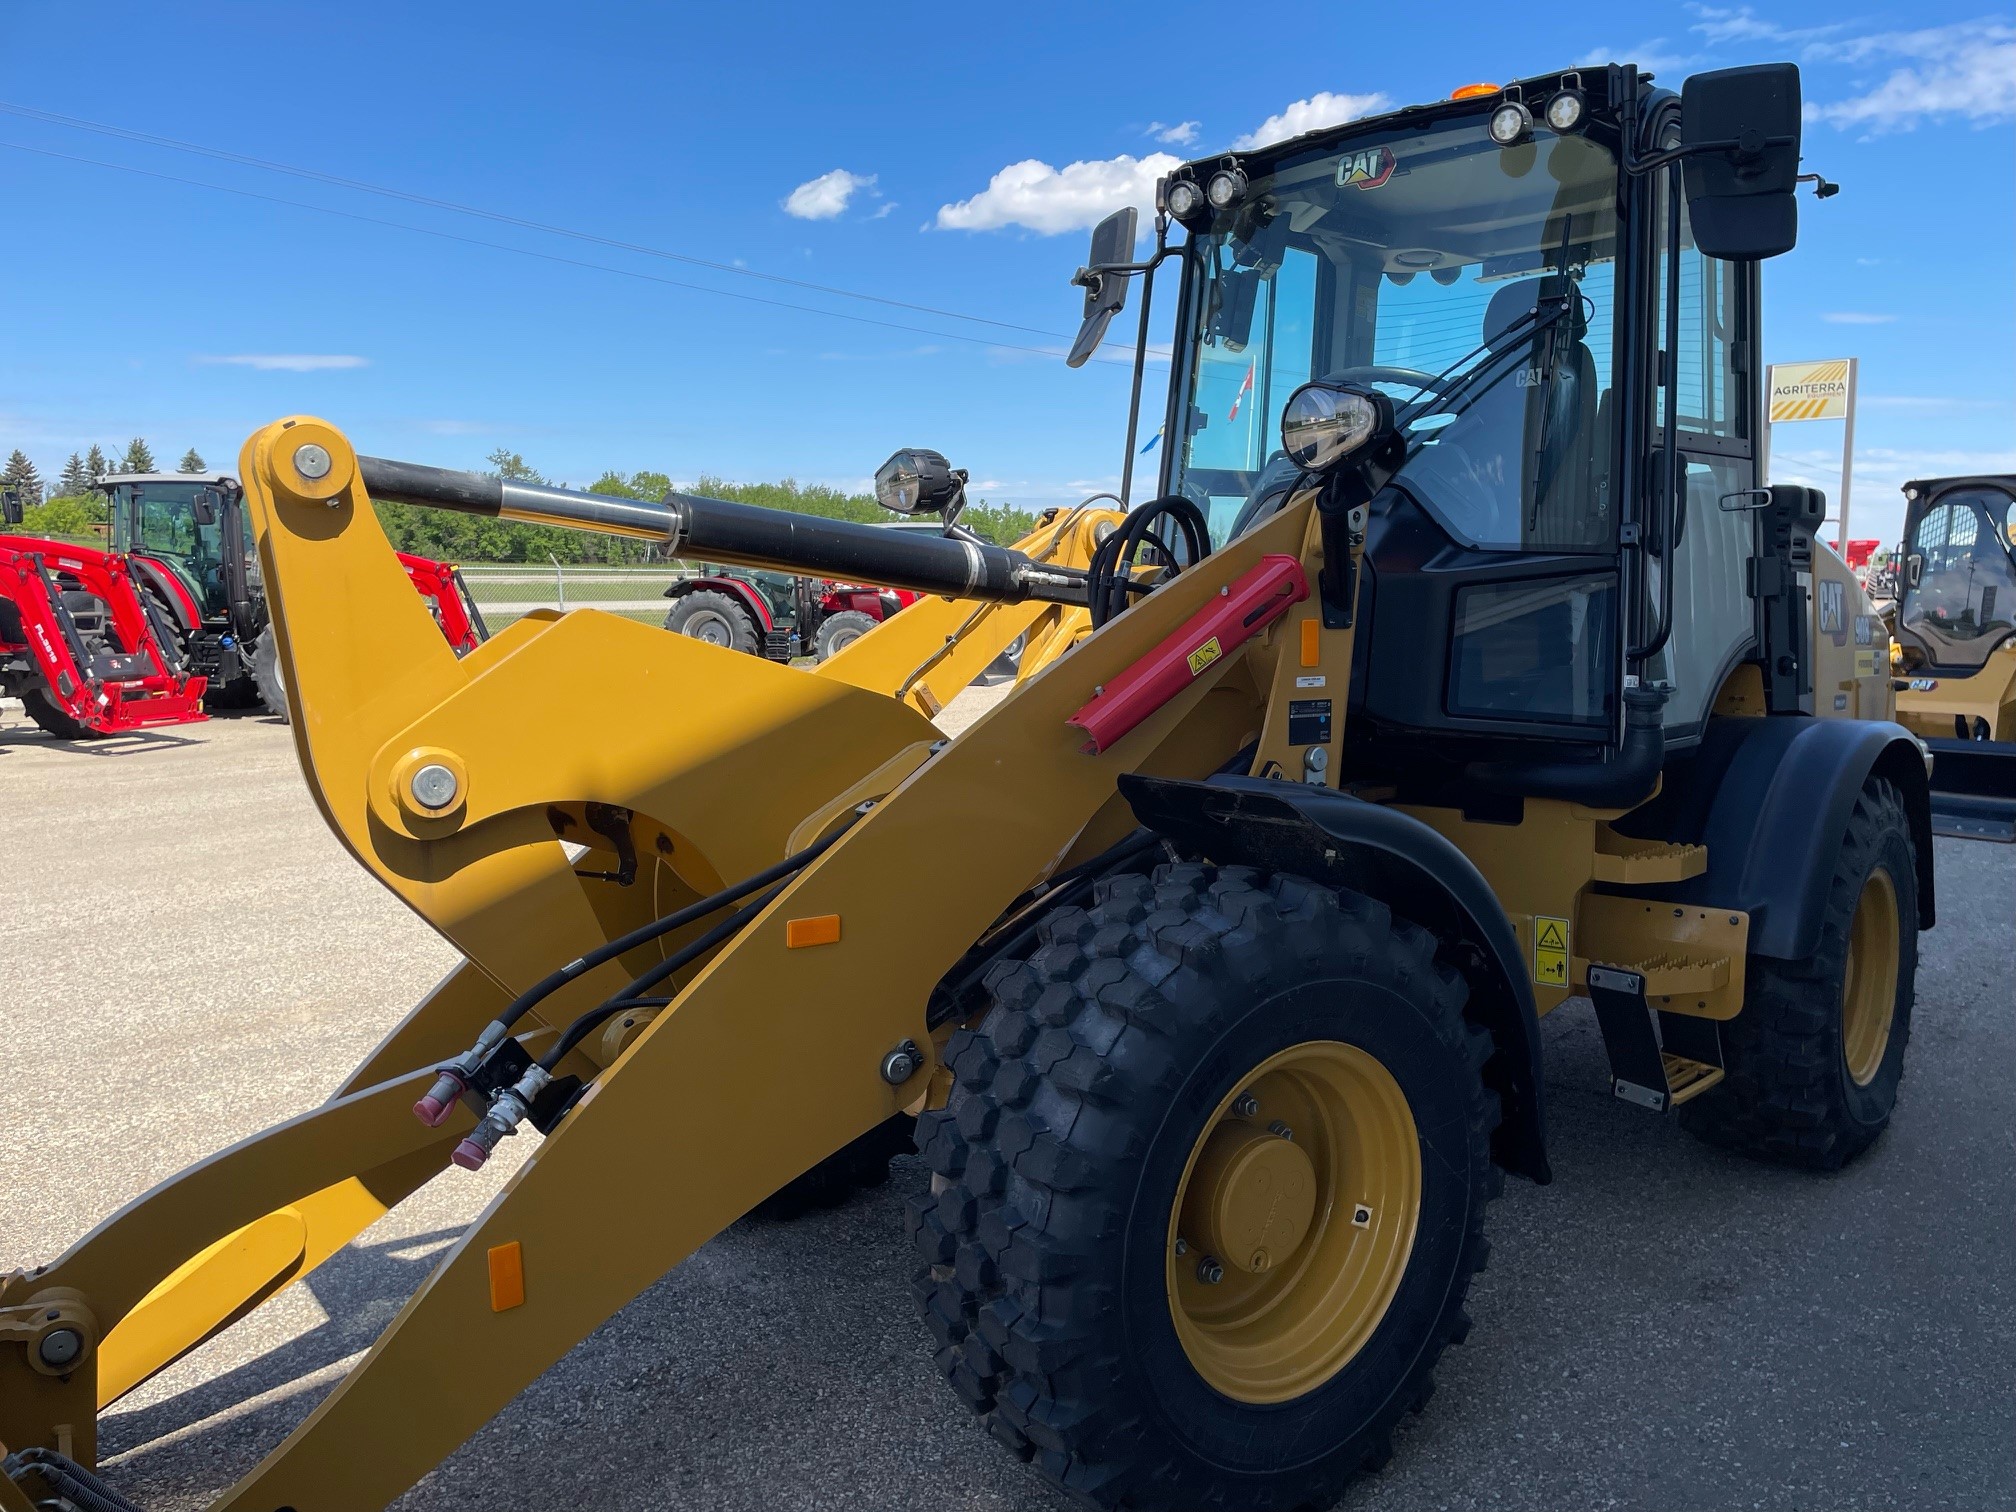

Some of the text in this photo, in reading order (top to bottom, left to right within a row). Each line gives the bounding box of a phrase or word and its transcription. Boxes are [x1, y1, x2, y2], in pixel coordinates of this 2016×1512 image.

[1337, 149, 1382, 186] CAT
[1515, 368, 1542, 388] CAT
[1774, 382, 1846, 396] AGRITERRA
[1807, 391, 1845, 399] EQUIPMENT
[1819, 582, 1843, 632] CAT
[1855, 616, 1870, 644] 908
[1910, 679, 1935, 691] CAT
